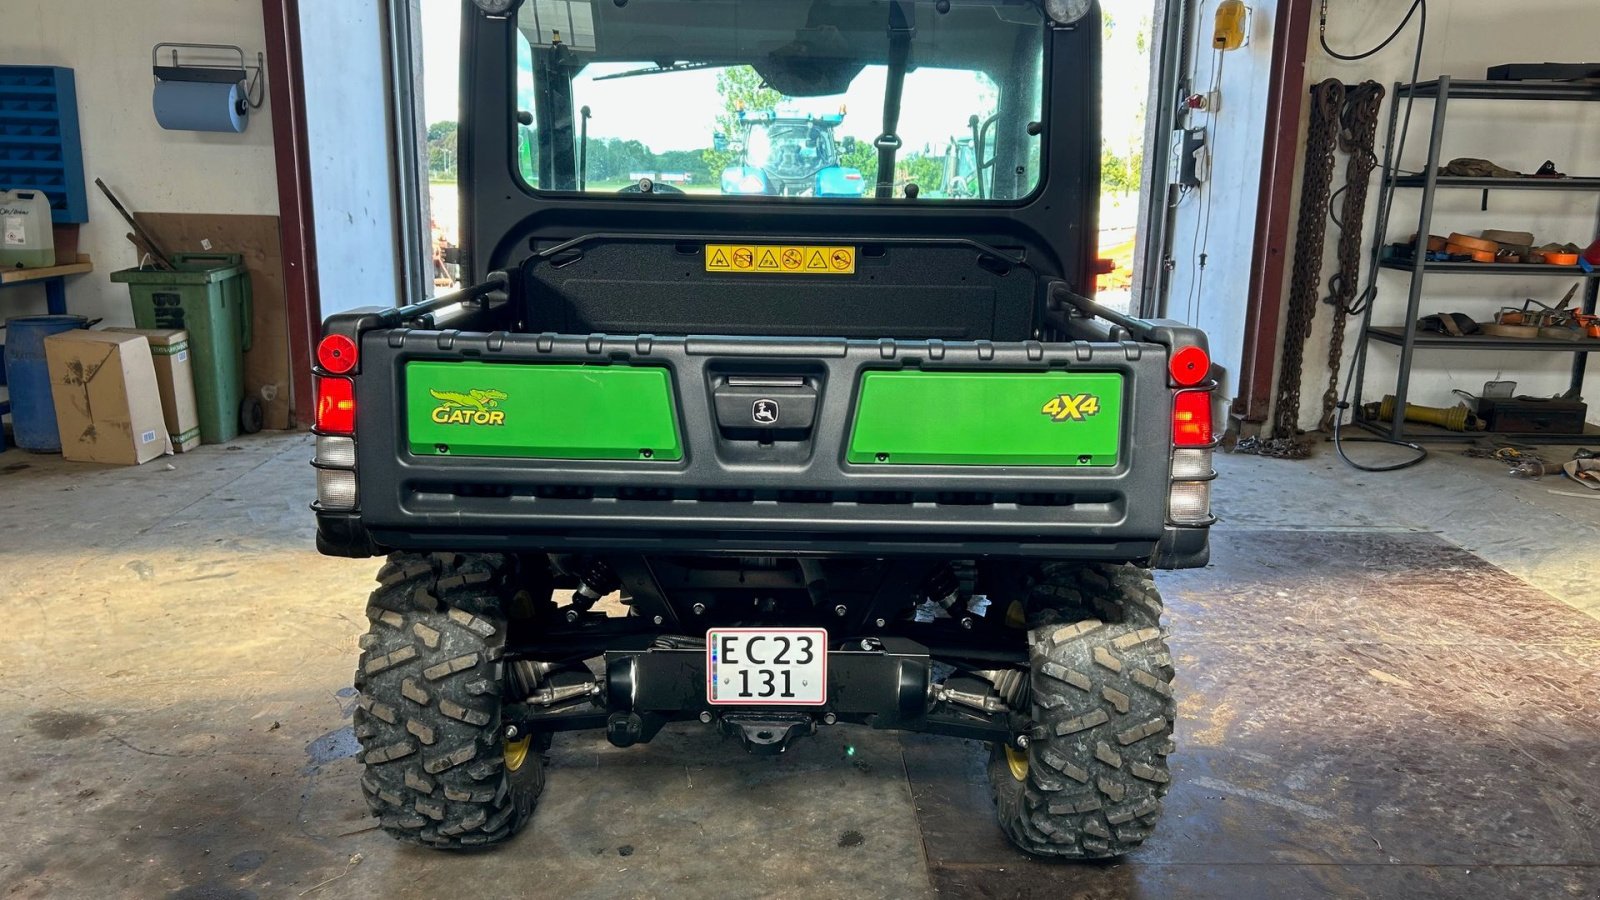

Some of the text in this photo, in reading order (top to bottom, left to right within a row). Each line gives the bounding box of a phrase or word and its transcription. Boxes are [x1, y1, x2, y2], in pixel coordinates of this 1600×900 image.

[431, 406, 505, 425] GATOR
[1042, 394, 1099, 420] 4X4
[738, 669, 795, 698] 131
